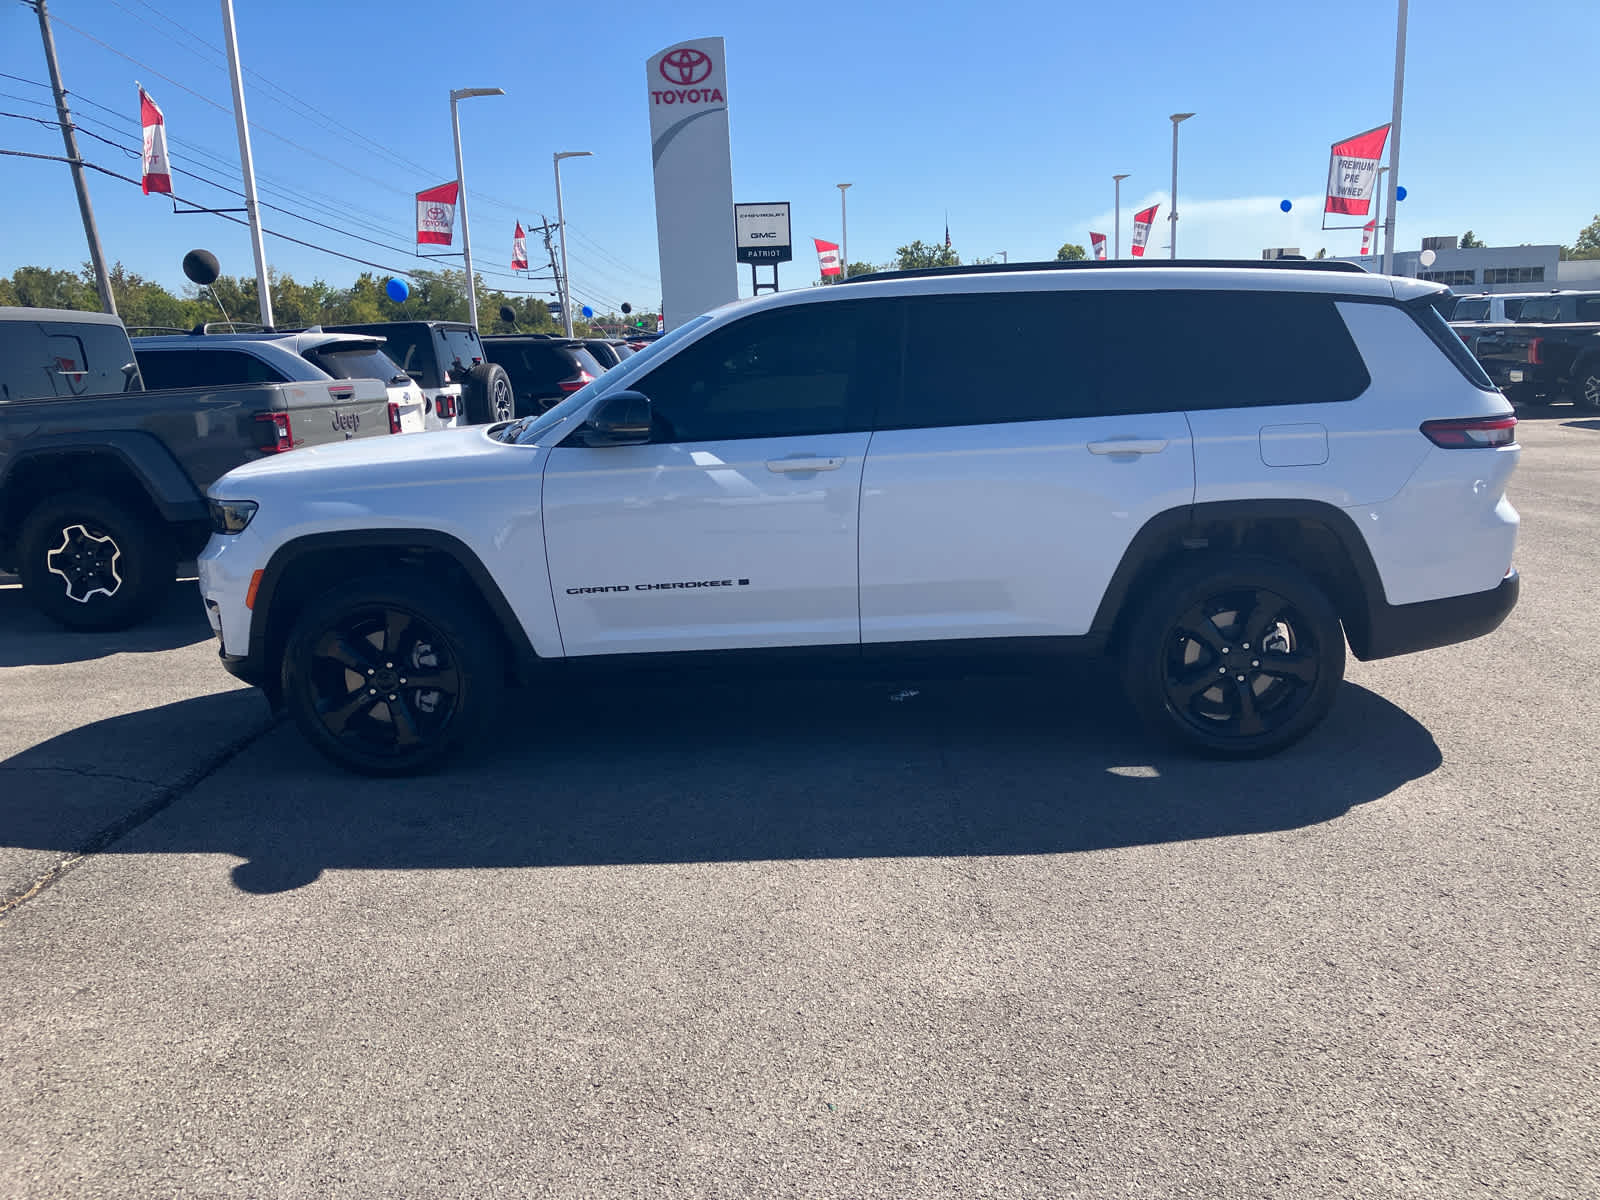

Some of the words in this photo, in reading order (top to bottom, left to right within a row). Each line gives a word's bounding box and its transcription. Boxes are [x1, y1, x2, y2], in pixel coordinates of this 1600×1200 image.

[651, 88, 724, 104] TOYOTA
[1338, 159, 1375, 172] PREMIUM
[1343, 173, 1361, 184] PRE
[422, 219, 449, 228] TOYOTA
[332, 410, 360, 433] Jeep
[566, 585, 630, 595] GRAND
[635, 580, 733, 591] CHEROKEE
